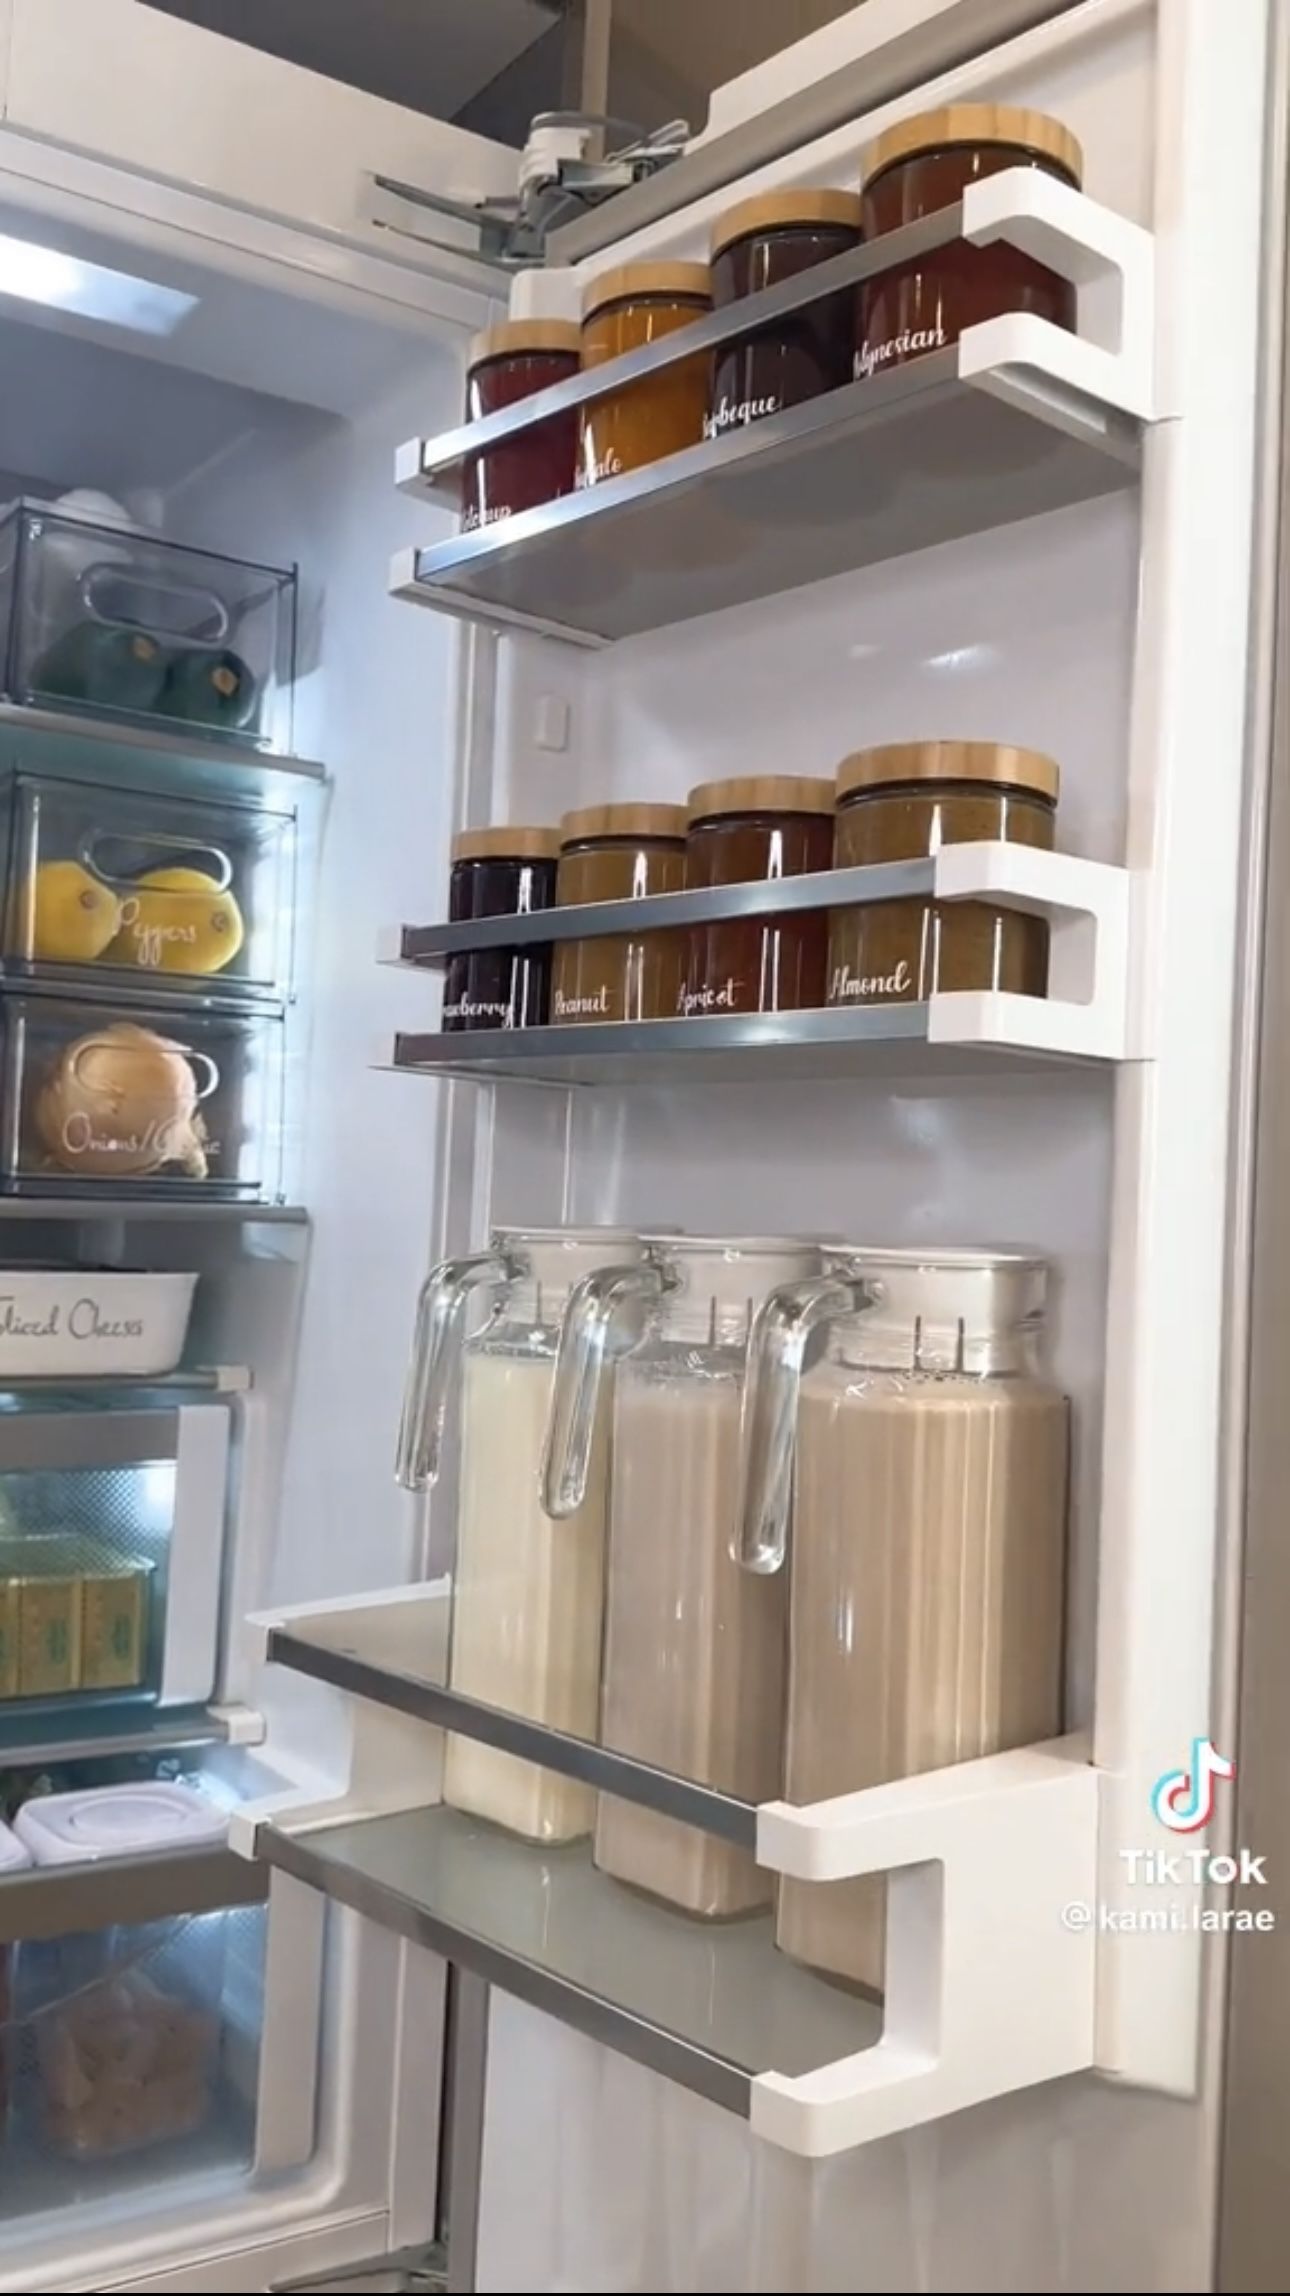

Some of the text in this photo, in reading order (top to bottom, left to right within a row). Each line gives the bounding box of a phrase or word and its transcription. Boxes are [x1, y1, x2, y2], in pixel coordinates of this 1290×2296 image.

[112, 897, 197, 966] Peppers
[555, 984, 615, 1015] Peanut
[676, 977, 745, 1017] Apricot
[828, 960, 911, 1000] Almond
